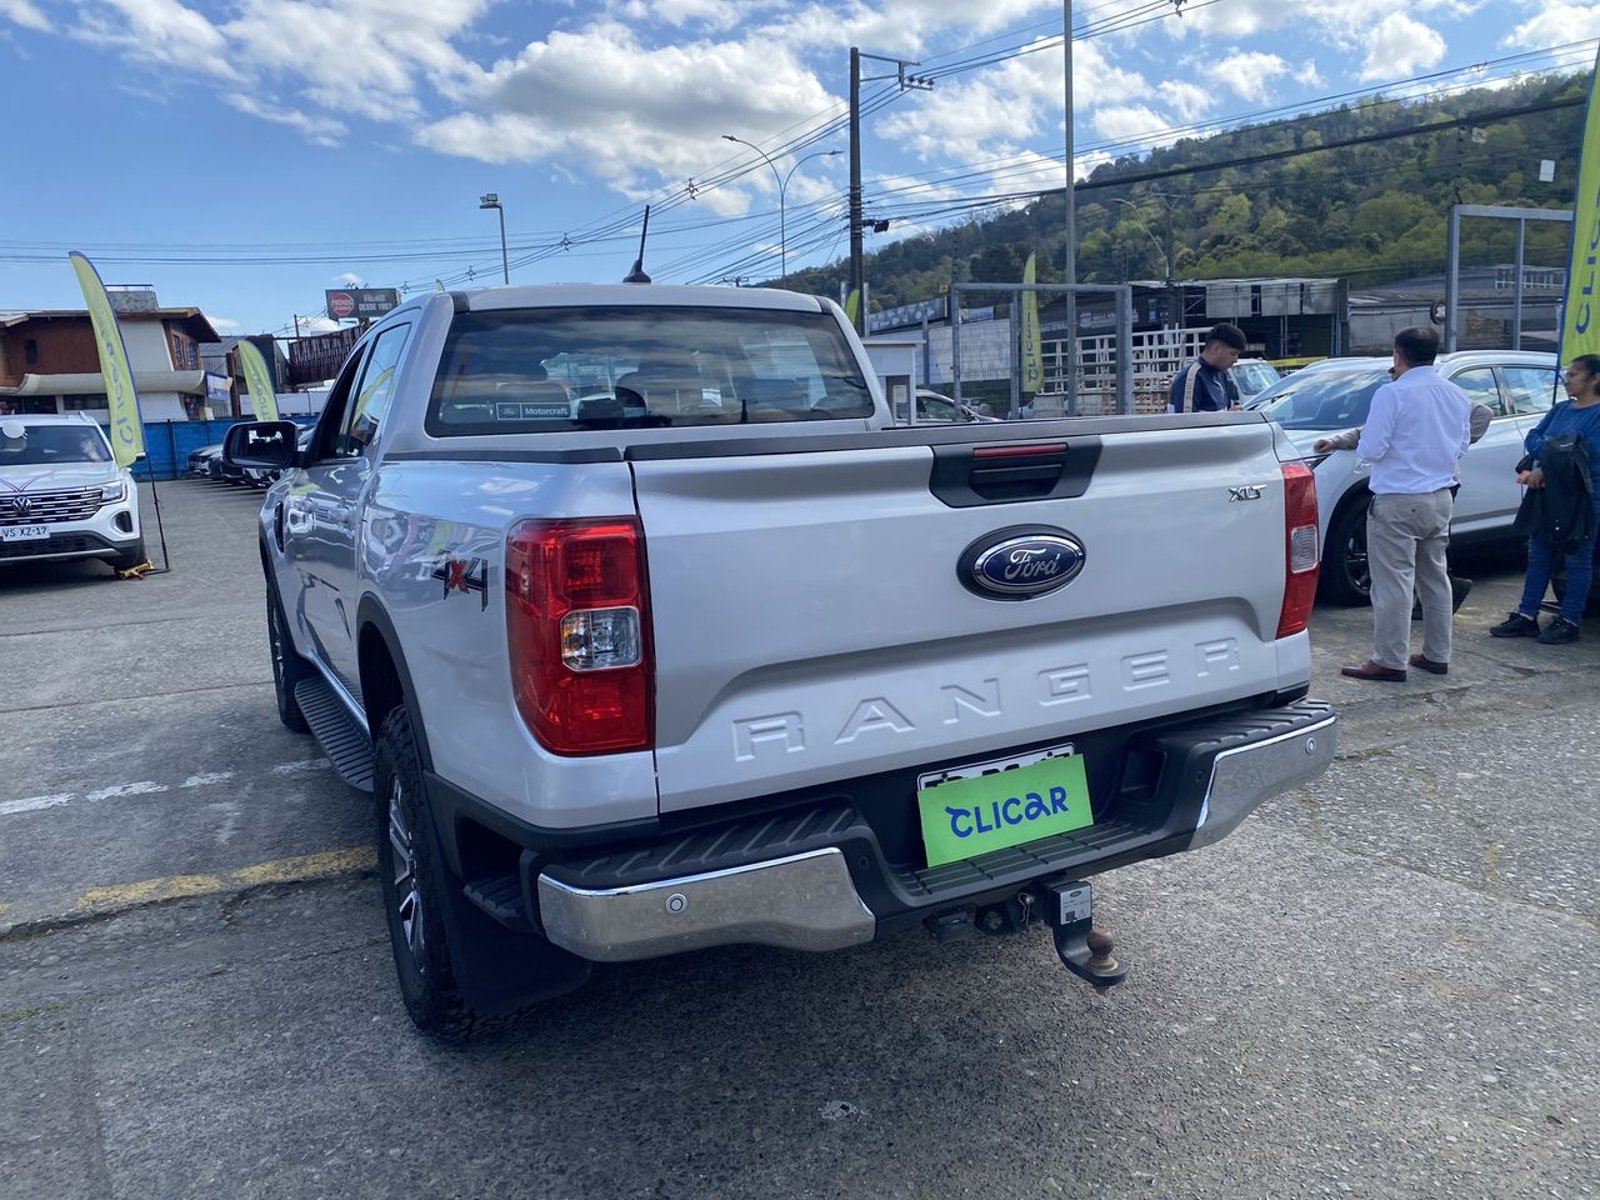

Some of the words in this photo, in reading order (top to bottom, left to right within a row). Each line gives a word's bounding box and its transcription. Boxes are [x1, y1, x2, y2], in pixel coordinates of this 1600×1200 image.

[1575, 185, 1600, 334] CLIC
[525, 407, 569, 416] Motorcraft
[1228, 484, 1268, 502] XLT
[1004, 548, 1060, 580] Ford
[732, 637, 1240, 763] RANGER
